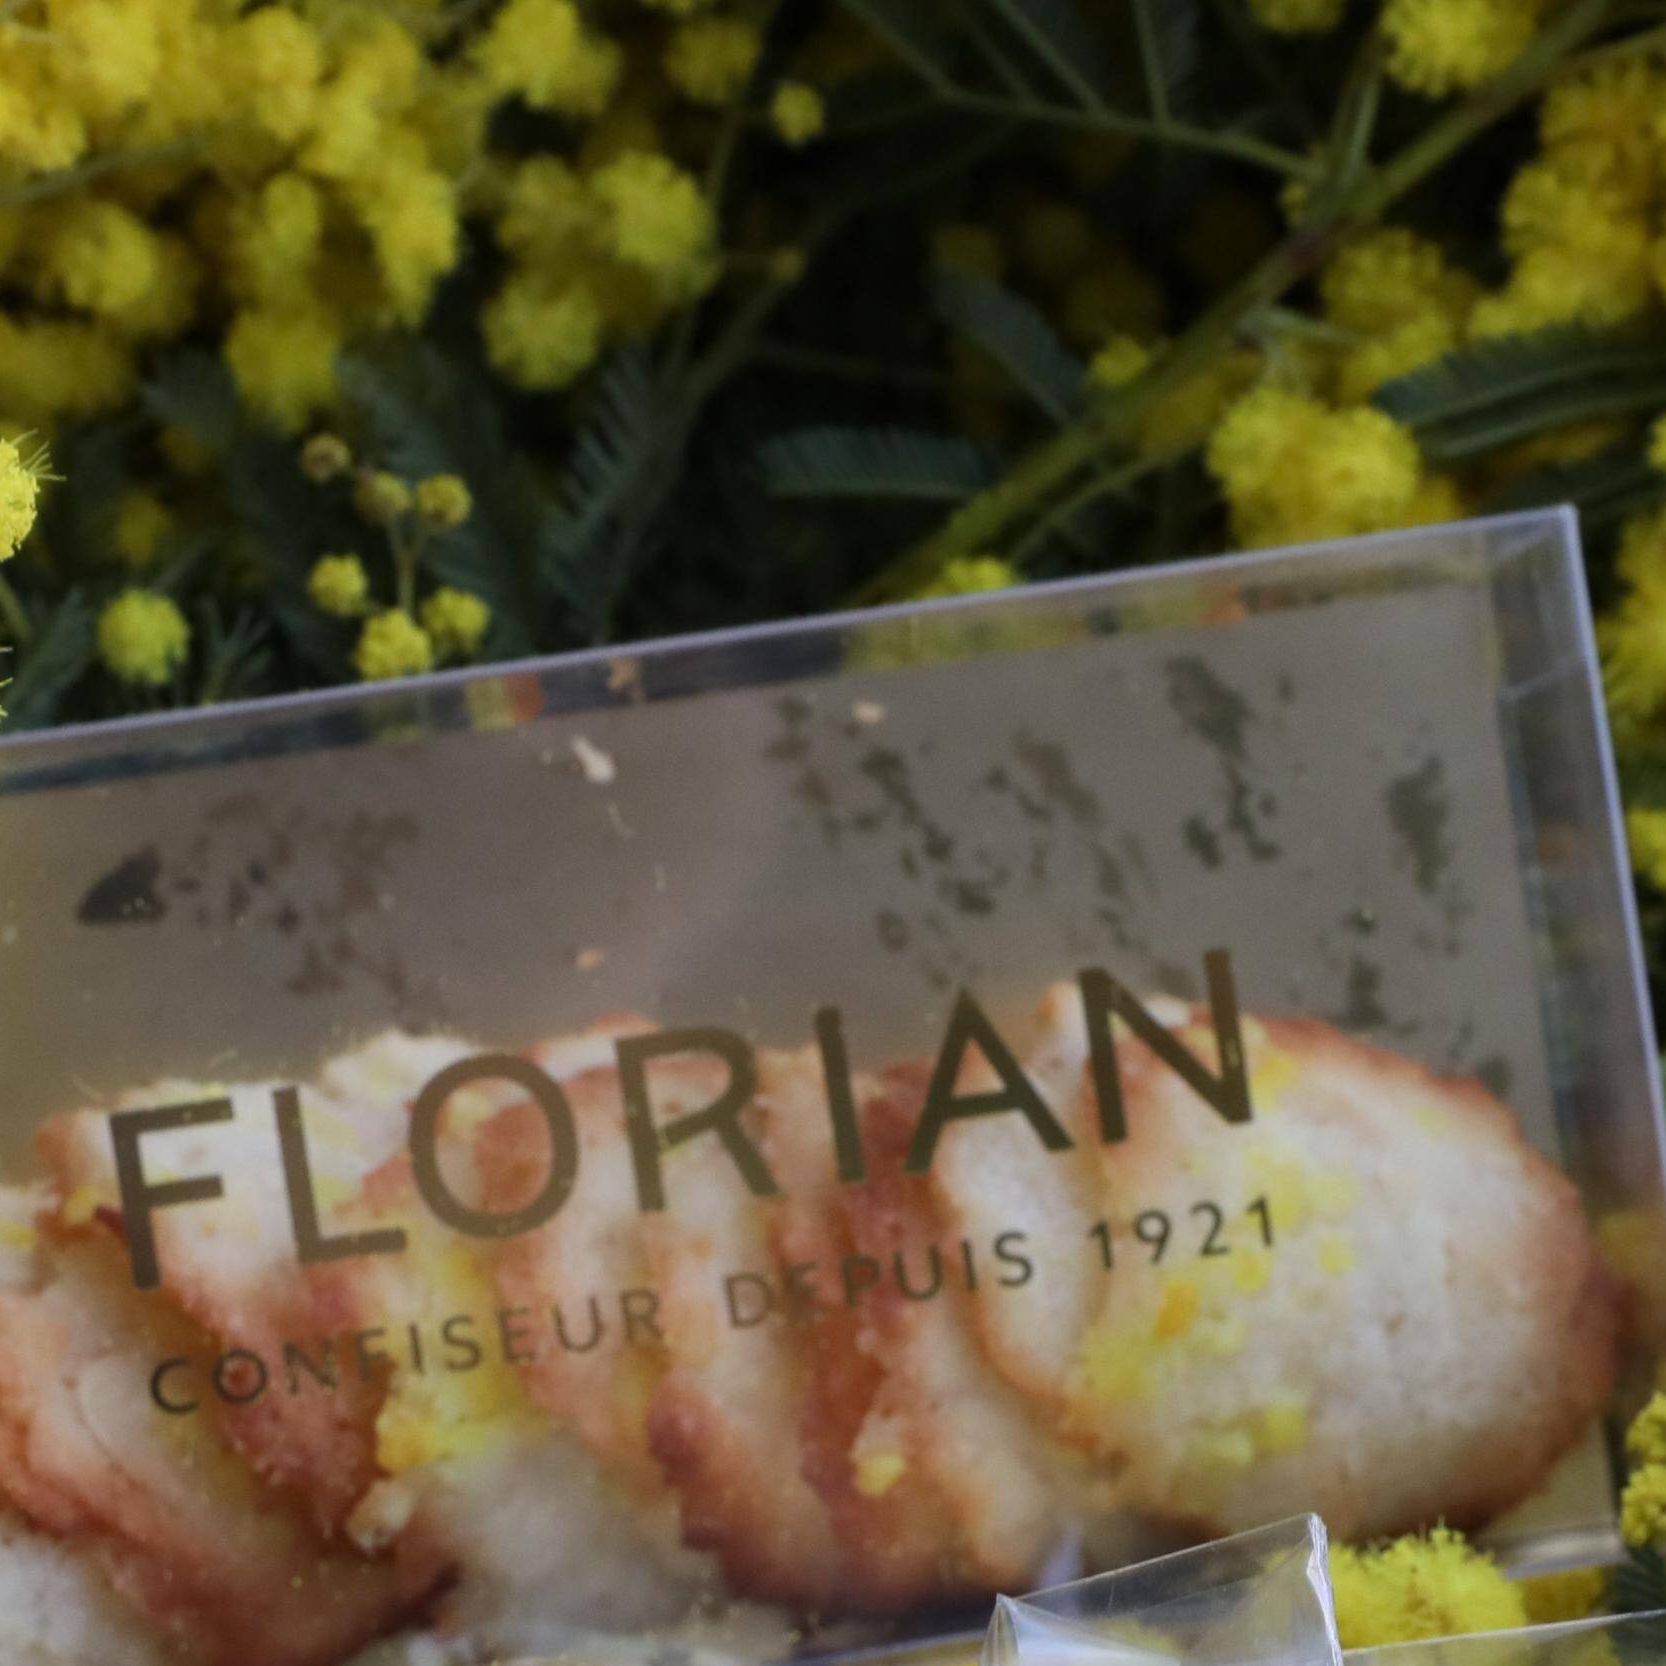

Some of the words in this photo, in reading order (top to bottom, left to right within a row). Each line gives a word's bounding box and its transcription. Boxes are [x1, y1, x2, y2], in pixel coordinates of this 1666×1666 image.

[109, 948, 1252, 1289] FLORIAN
[149, 1288, 666, 1416] CONFISEUR
[723, 1230, 1035, 1330] DEPUIS
[1089, 1194, 1275, 1272] 1921
